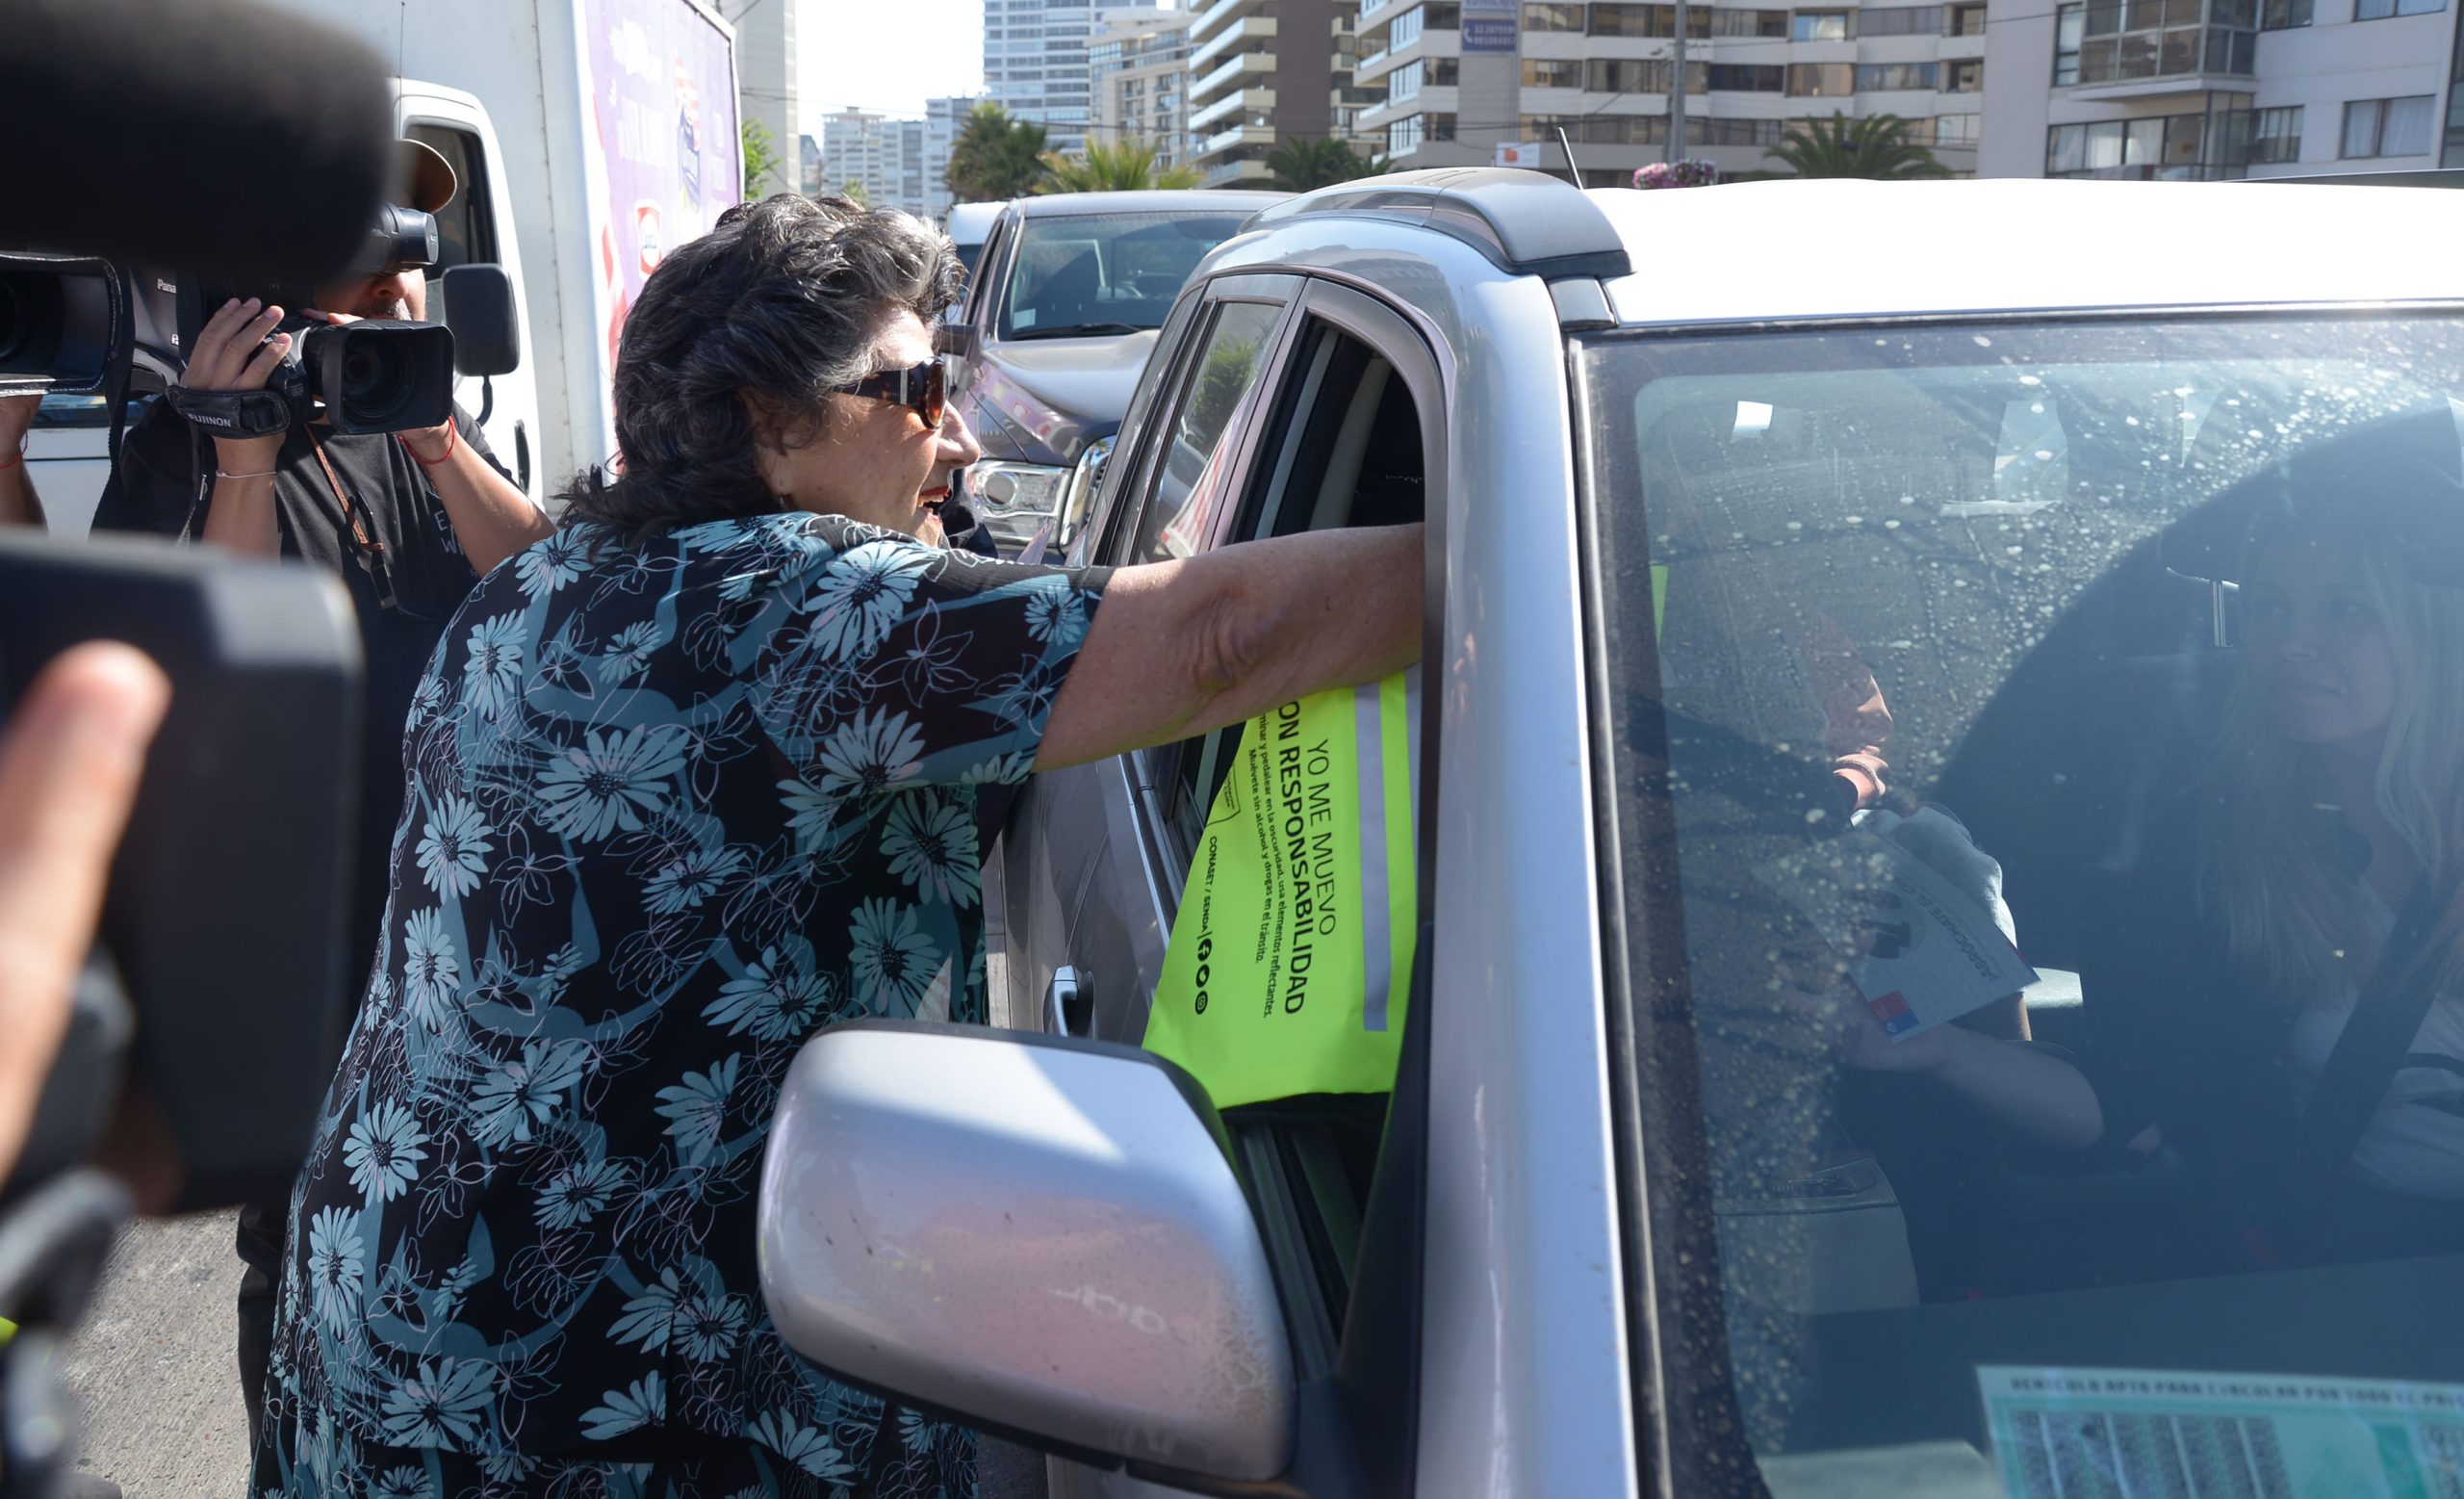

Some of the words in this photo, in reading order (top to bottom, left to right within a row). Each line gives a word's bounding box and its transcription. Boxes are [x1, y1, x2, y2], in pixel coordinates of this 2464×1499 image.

[1258, 713, 1269, 741] minar
[1277, 700, 1300, 741] ON
[1248, 748, 1260, 794] Muévete
[1260, 751, 1272, 795] pedalear
[1307, 738, 1330, 776] YO
[1253, 794, 1262, 812] sin
[1266, 798, 1273, 812] en
[1267, 812, 1275, 823] la
[1308, 783, 1332, 827] ME
[1255, 812, 1269, 851] alcohol
[1205, 835, 1218, 886] CONASET
[1269, 824, 1285, 880] oscuridad,
[1264, 862, 1272, 896] drogas
[1279, 745, 1314, 1015] RESPONSABILIDAD
[1312, 832, 1337, 936] MUEVO
[1201, 895, 1212, 933] SENDA
[1262, 912, 1272, 921] el
[1264, 898, 1272, 911] en
[1272, 900, 1287, 953] elementos
[1263, 955, 1281, 1019] reflectantes.
